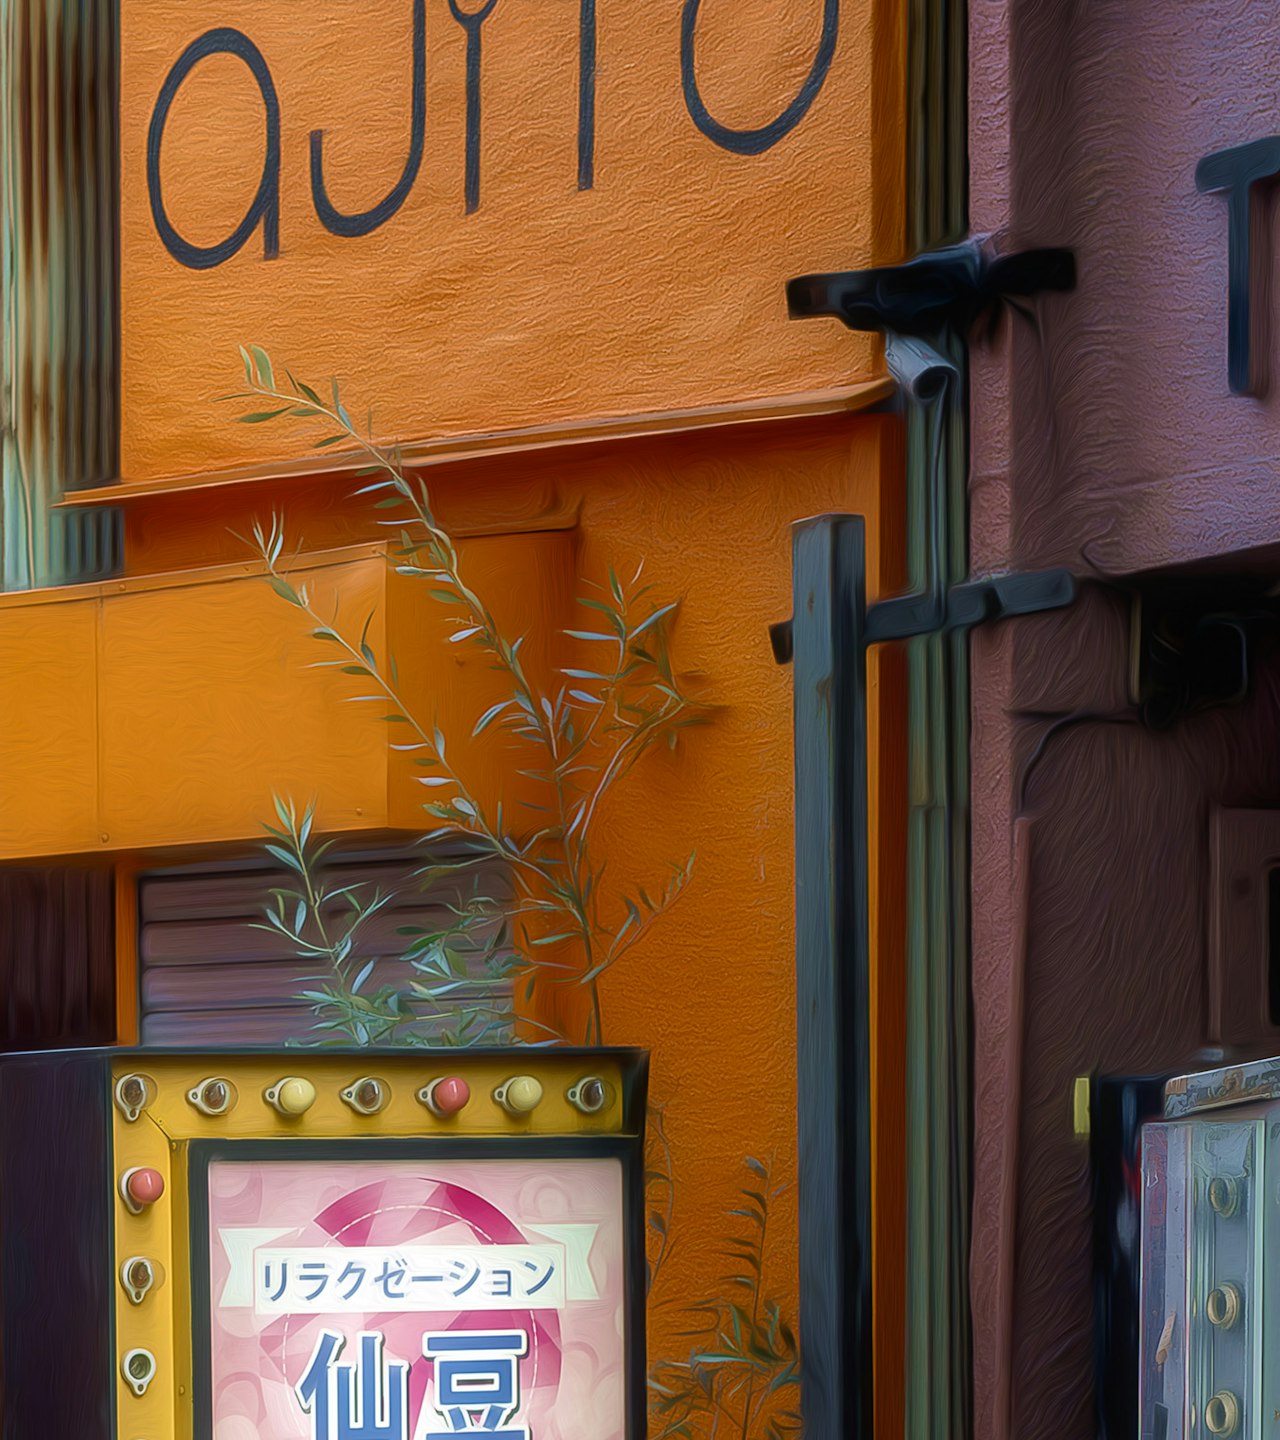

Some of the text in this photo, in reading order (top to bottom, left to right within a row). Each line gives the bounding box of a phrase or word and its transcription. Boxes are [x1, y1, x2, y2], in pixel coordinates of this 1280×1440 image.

[263, 1259, 555, 1303] リラクゼーション
